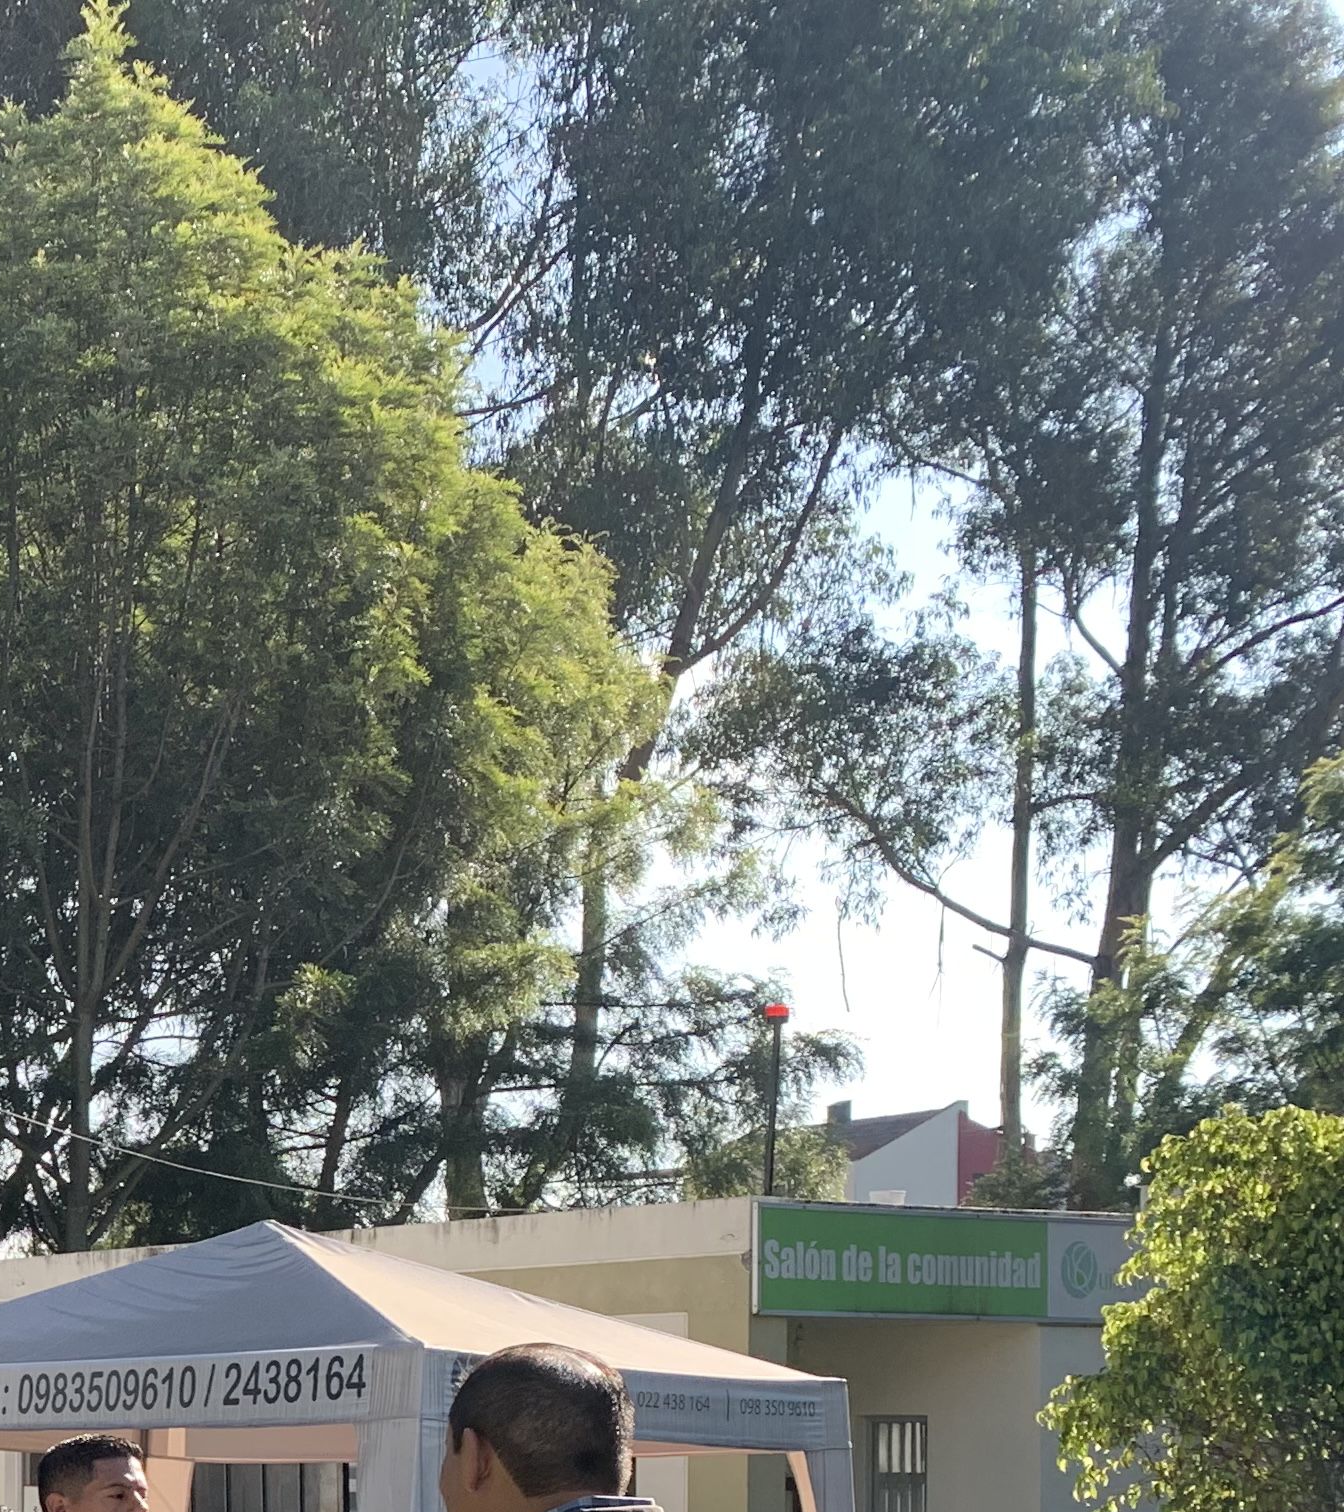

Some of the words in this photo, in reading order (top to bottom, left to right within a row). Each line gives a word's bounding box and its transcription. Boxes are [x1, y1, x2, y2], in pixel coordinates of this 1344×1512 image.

[763, 1238, 837, 1281] Salón
[842, 1244, 873, 1283] de
[878, 1245, 902, 1284] la
[907, 1250, 1041, 1289] comunidad
[17, 1364, 197, 1415] 0983509610
[203, 1363, 216, 1408] /
[222, 1353, 367, 1407] 2438164
[637, 1391, 660, 1408] 022
[663, 1392, 686, 1411] 438
[739, 1399, 762, 1415] 098
[764, 1399, 786, 1416] 350
[787, 1400, 816, 1417] 9610
